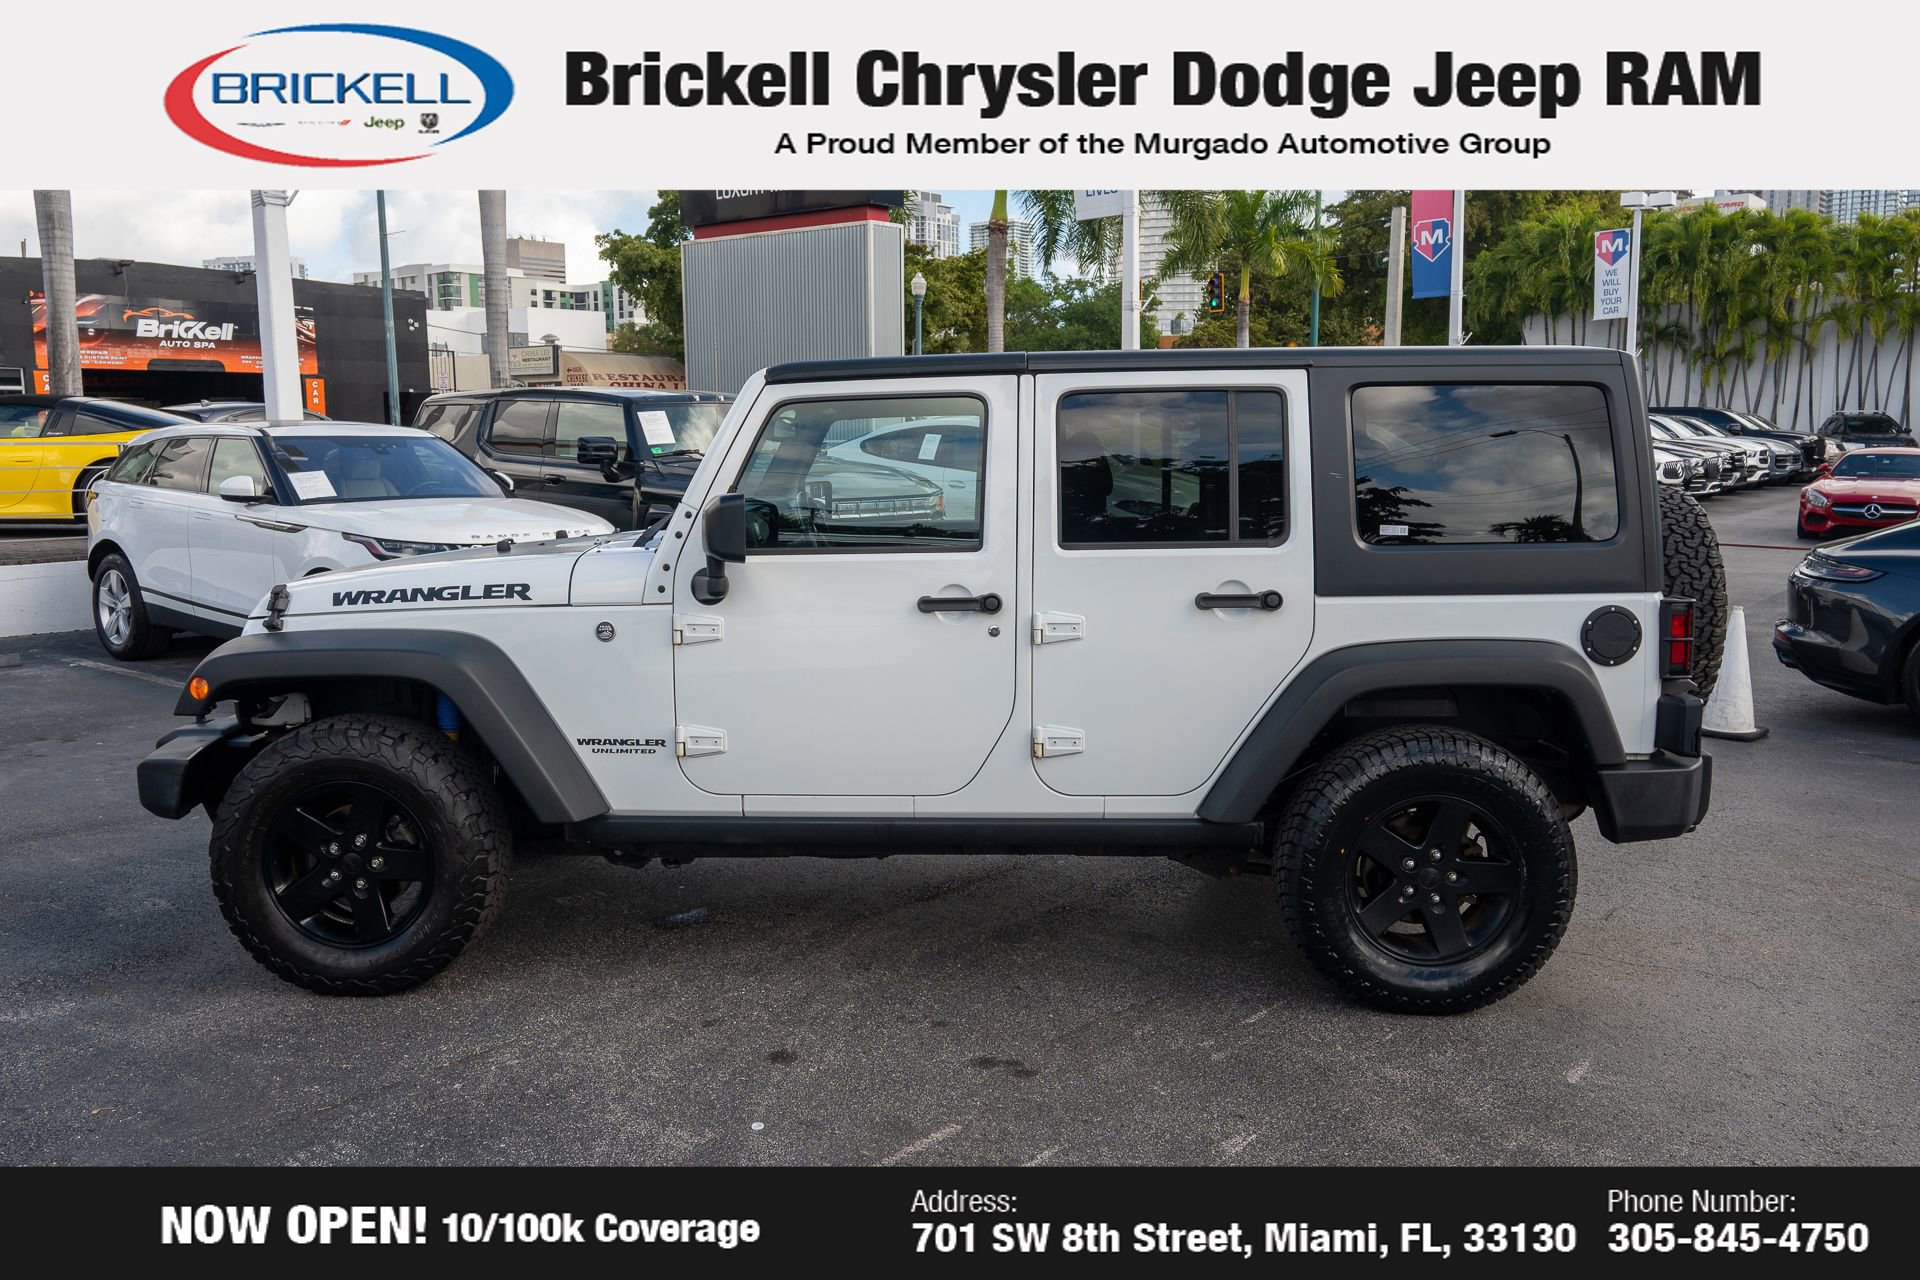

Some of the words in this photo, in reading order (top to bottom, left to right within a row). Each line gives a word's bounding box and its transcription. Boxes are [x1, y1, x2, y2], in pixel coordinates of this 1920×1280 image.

[1421, 229, 1443, 246] M
[1601, 238, 1623, 254] M
[1605, 269, 1618, 277] WE
[1602, 279, 1621, 287] WILL
[1603, 288, 1619, 296] BUY
[1600, 297, 1622, 306] YOUR
[1602, 306, 1619, 315] CAR
[159, 340, 191, 348] AUTO
[566, 373, 588, 383] CHINESE
[332, 583, 533, 607] WRANGLER
[576, 738, 667, 747] WRANGLER
